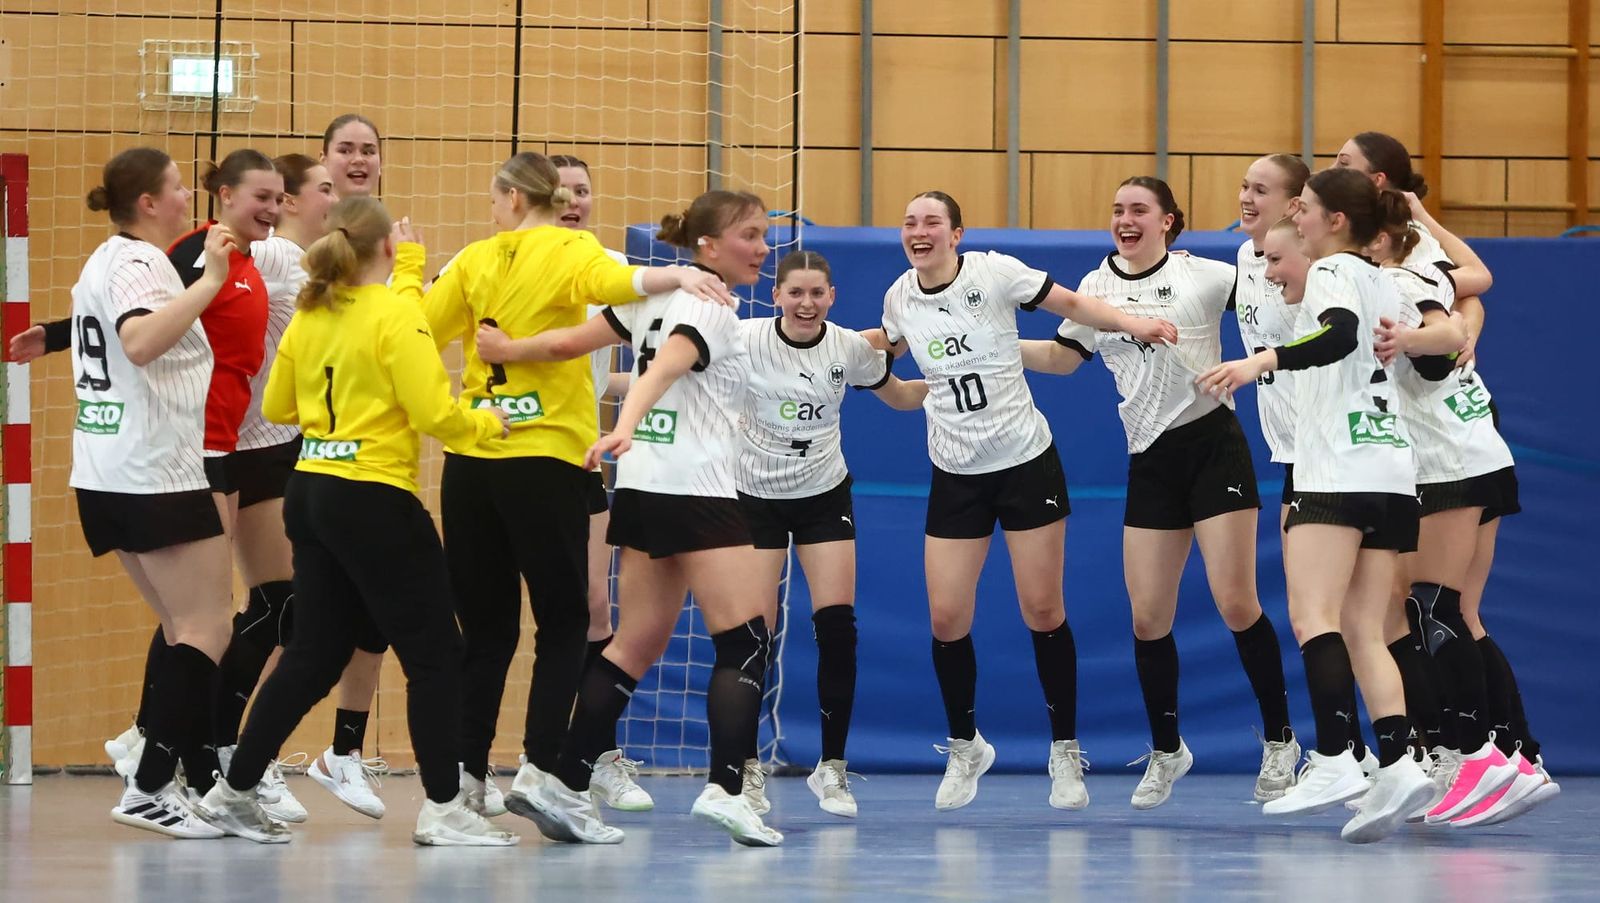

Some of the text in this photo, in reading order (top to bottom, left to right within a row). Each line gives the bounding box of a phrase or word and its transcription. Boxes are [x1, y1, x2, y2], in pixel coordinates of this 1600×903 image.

[1238, 303, 1259, 326] eak
[928, 334, 973, 360] eak
[948, 372, 988, 413] 10
[780, 400, 826, 421] eak
